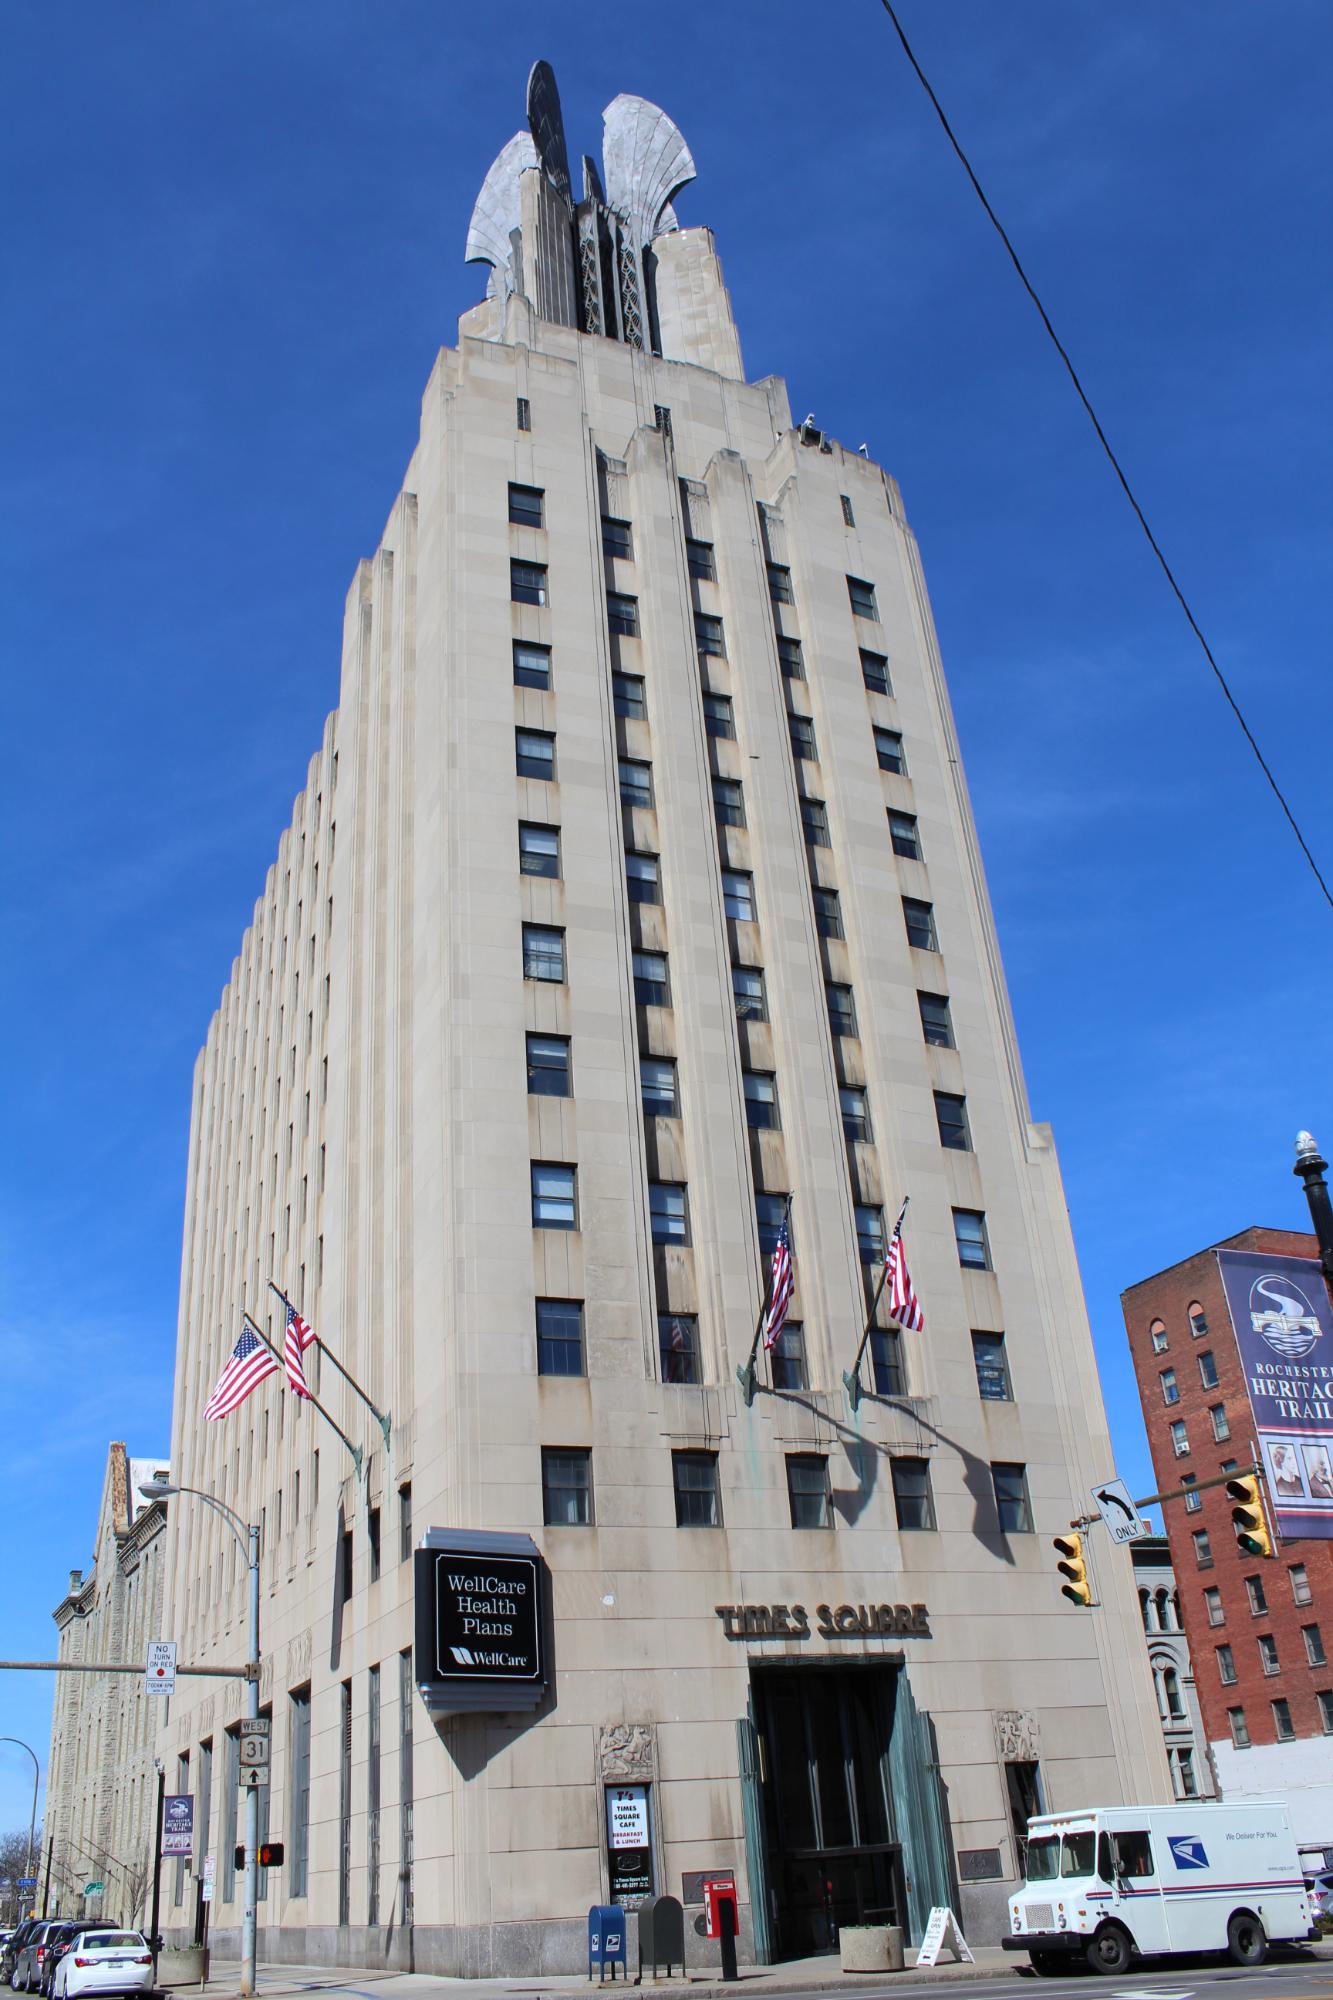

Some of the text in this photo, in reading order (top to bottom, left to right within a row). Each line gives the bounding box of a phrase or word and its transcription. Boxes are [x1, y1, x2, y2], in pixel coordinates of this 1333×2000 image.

[1250, 1377, 1333, 1399] HERITAG
[1275, 1400, 1333, 1419] TRAIL
[1115, 1523, 1139, 1539] ONLY
[448, 1575, 526, 1594] WellCare
[457, 1596, 517, 1615] Health
[463, 1618, 513, 1636] Plans
[714, 1604, 931, 1634] TIMES SQUARE
[156, 1645, 169, 1653] NO
[473, 1651, 527, 1666] WellCare
[243, 1721, 267, 1731] WEST
[246, 1741, 264, 1758] 31
[617, 1791, 634, 1801] T's
[1225, 1832, 1235, 1840] We
[1235, 1832, 1255, 1840] Deliver
[1256, 1831, 1265, 1839] For
